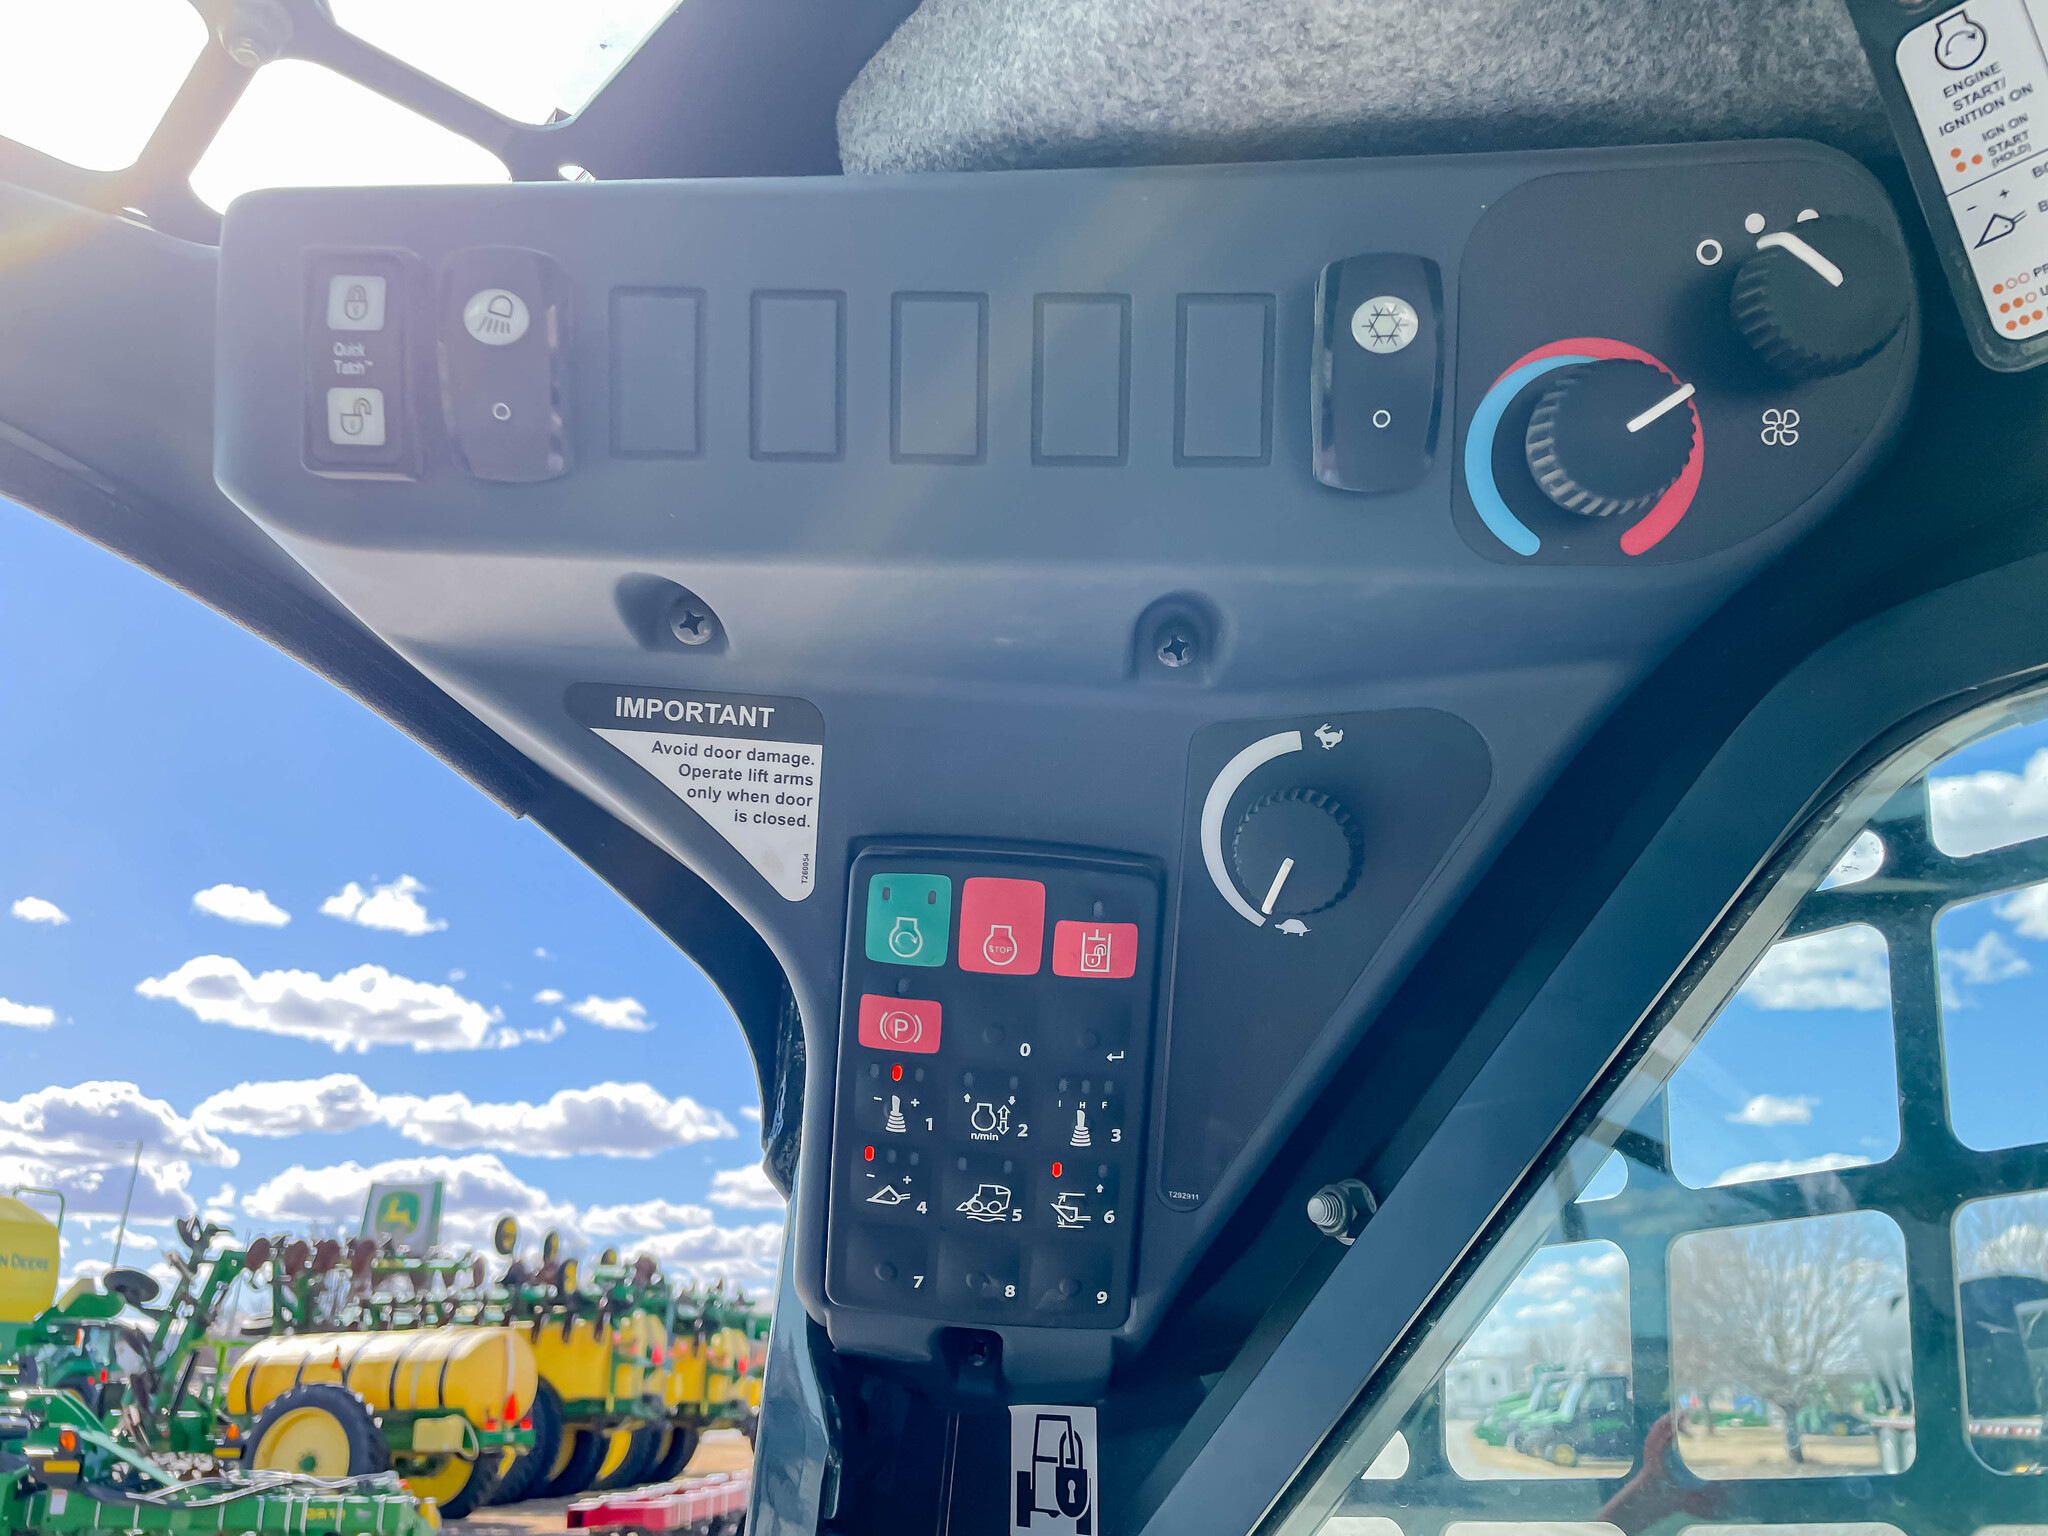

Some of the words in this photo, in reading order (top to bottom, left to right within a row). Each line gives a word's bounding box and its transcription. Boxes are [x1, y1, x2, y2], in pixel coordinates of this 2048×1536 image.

[1943, 61, 2002, 98] ENGINE
[1953, 76, 2006, 111] START/
[1939, 96, 2006, 137] IGNITION
[2009, 83, 2034, 101] ON
[1982, 124, 2006, 142] IGN
[2008, 113, 2029, 129] ON
[1987, 130, 2029, 156] START
[1991, 143, 2032, 169] (HOLD)
[616, 696, 775, 728] IMPORTANT
[651, 740, 698, 757] Avoid
[703, 744, 742, 760] door
[746, 747, 815, 768] damage.
[678, 763, 743, 781] Operate
[748, 768, 769, 783] lift
[773, 773, 814, 786] arms
[687, 786, 722, 803] only
[727, 788, 770, 804] when
[775, 792, 813, 807] door
[734, 809, 748, 823] is
[753, 811, 811, 828] closed.
[988, 945, 1013, 954] STOP
[894, 1018, 909, 1039] P
[1020, 1042, 1031, 1057] 0
[1079, 1101, 1086, 1109] H
[1101, 1101, 1108, 1109] F
[925, 1117, 933, 1131] 1
[1017, 1123, 1028, 1138] 2
[970, 1132, 999, 1141] n/min
[1110, 1128, 1122, 1143] 3
[916, 1201, 928, 1215] 4
[1011, 1208, 1023, 1222] 5
[1103, 1210, 1115, 1224] 6
[913, 1275, 924, 1288] 7
[1004, 1284, 1016, 1298] 8
[1096, 1291, 1108, 1304] 9
